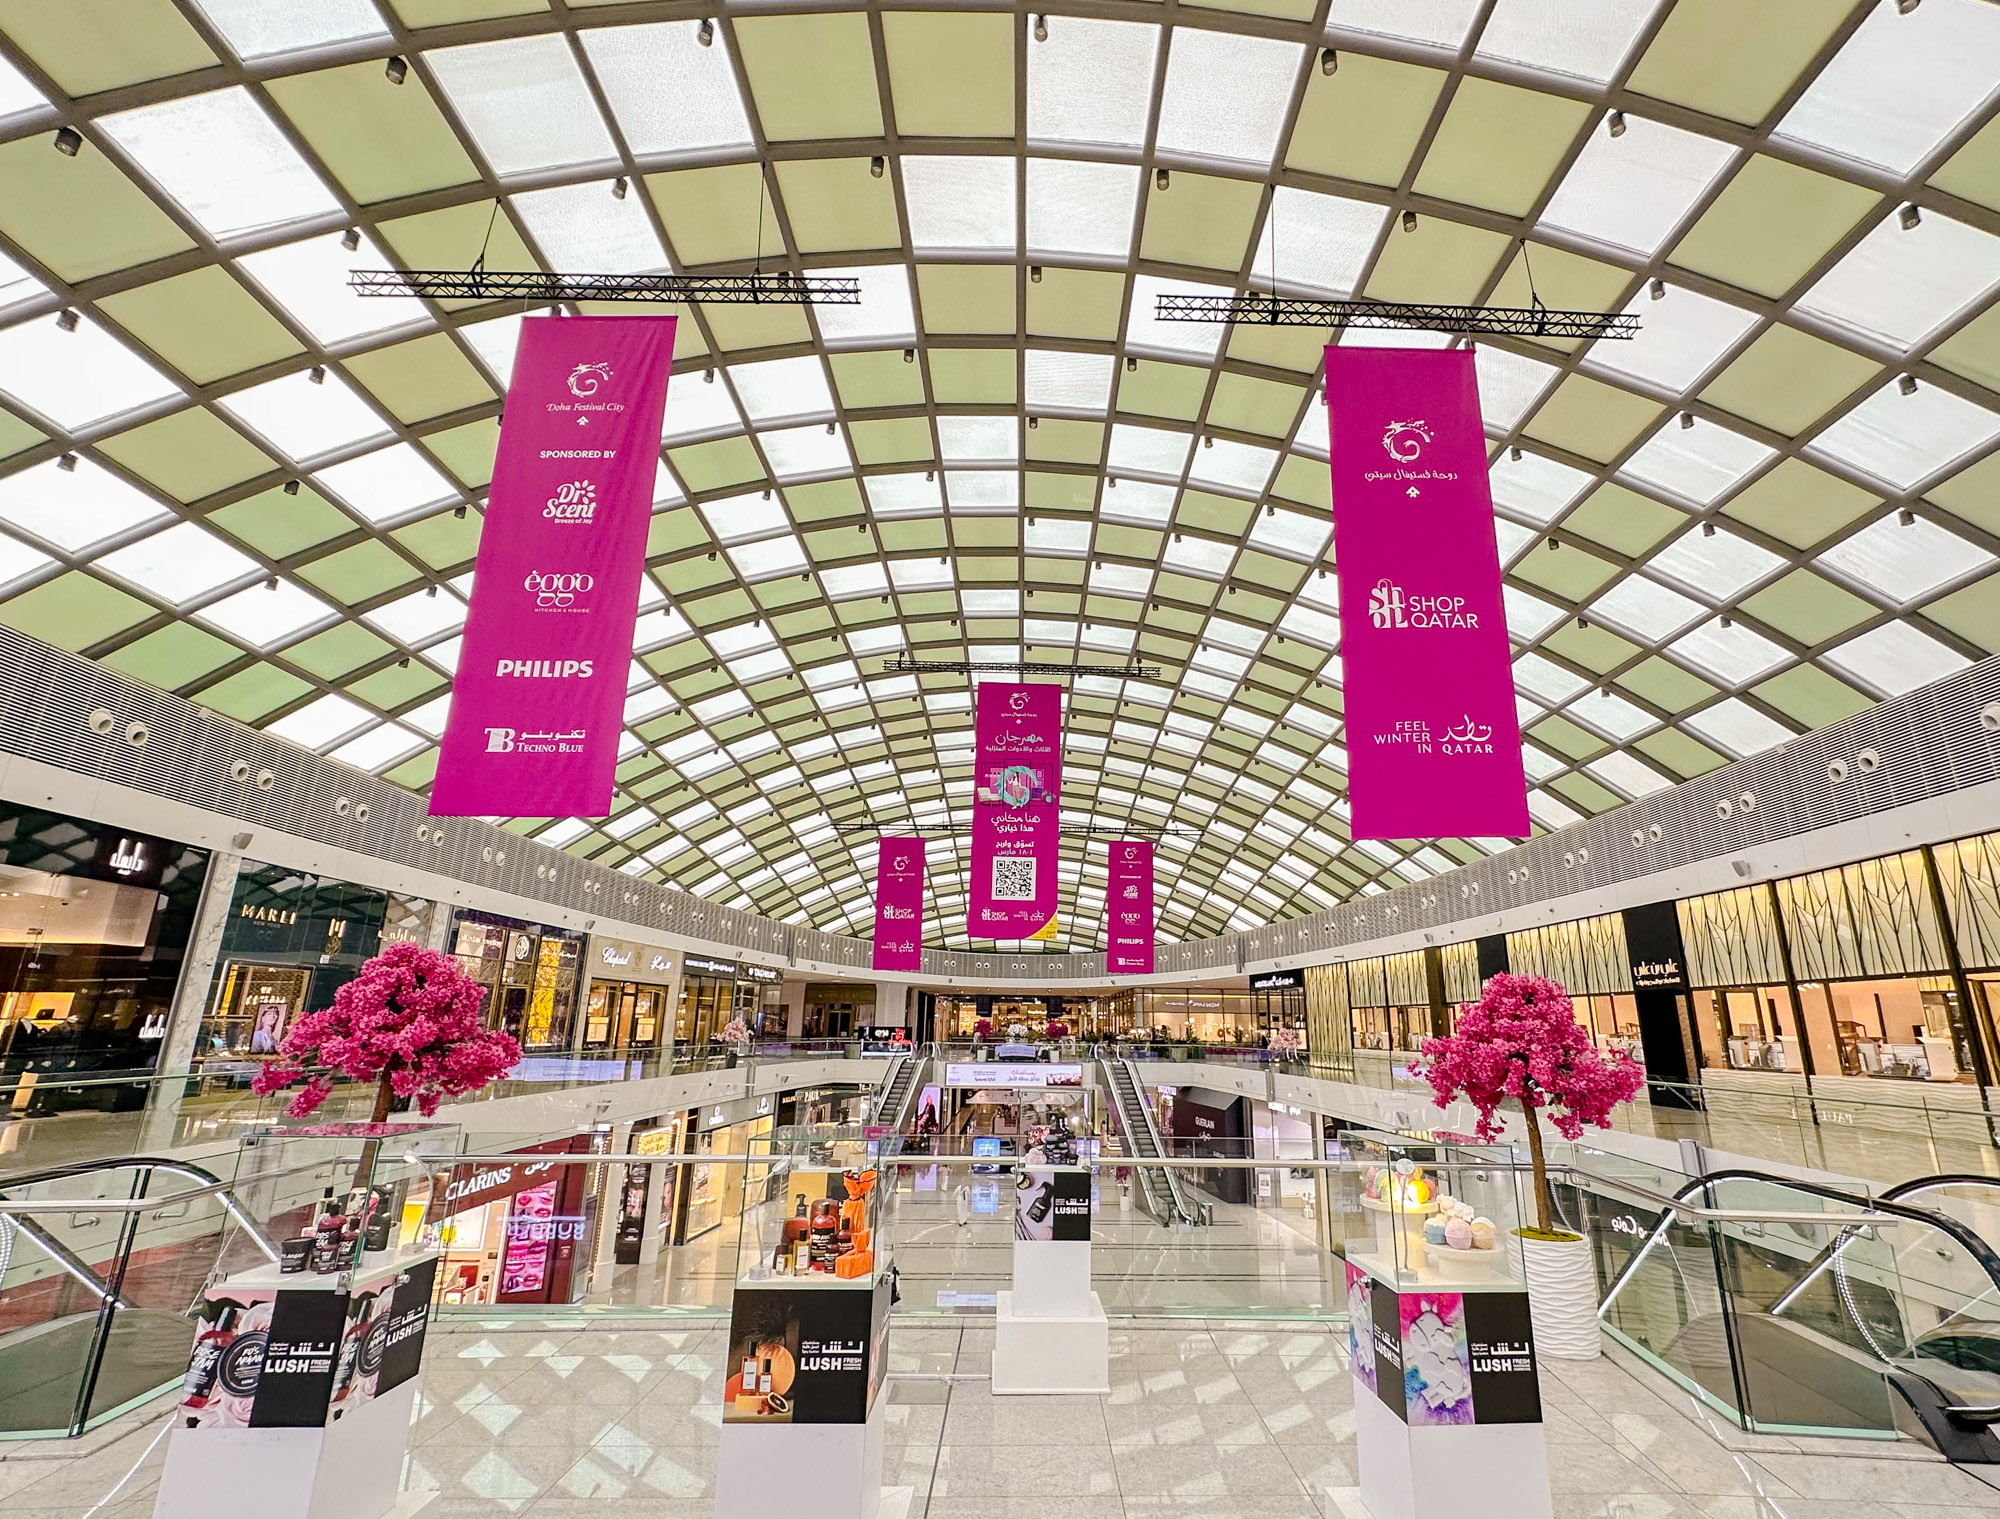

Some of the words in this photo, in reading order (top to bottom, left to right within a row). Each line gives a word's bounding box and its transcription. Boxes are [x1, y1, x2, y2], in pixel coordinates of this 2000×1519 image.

[546, 402, 571, 412] Doha
[573, 402, 605, 412] Festival
[606, 402, 624, 413] City
[540, 450, 601, 458] SPONSORED
[603, 450, 616, 458] BY
[1364, 471, 1392, 482] سيتي
[1393, 469, 1431, 481] فستيفال
[556, 483, 586, 504] Dr
[542, 498, 597, 518] Scent
[1409, 596, 1465, 612] SHOP
[1410, 613, 1479, 629] QATAR
[496, 659, 594, 678] PHILIPS
[1396, 721, 1430, 732] FEEL
[995, 730, 1044, 746] مهرجان
[1374, 732, 1431, 744] WINTER
[516, 742, 556, 753] TECHNO
[558, 742, 584, 753] BLUE
[1418, 744, 1432, 754] IN
[1442, 744, 1494, 756] QATAR
[990, 812, 1024, 826] مكاني
[1024, 812, 1041, 824] هنا
[996, 824, 1018, 834] خياري
[1020, 824, 1034, 832] هذا
[241, 904, 297, 925] MARLI
[602, 946, 632, 968] Chopard
[804, 1090, 820, 1102] PAUL
[1194, 1116, 1215, 1130] GUERLAIN
[445, 1166, 512, 1201] CLARINS
[1055, 1206, 1078, 1214] LUSH
[386, 1324, 412, 1347] LUSH
[1374, 1338, 1392, 1362] LUSH
[264, 1358, 310, 1374] LUSH
[800, 1356, 842, 1371] LUSH
[1472, 1358, 1512, 1372] LUSH
